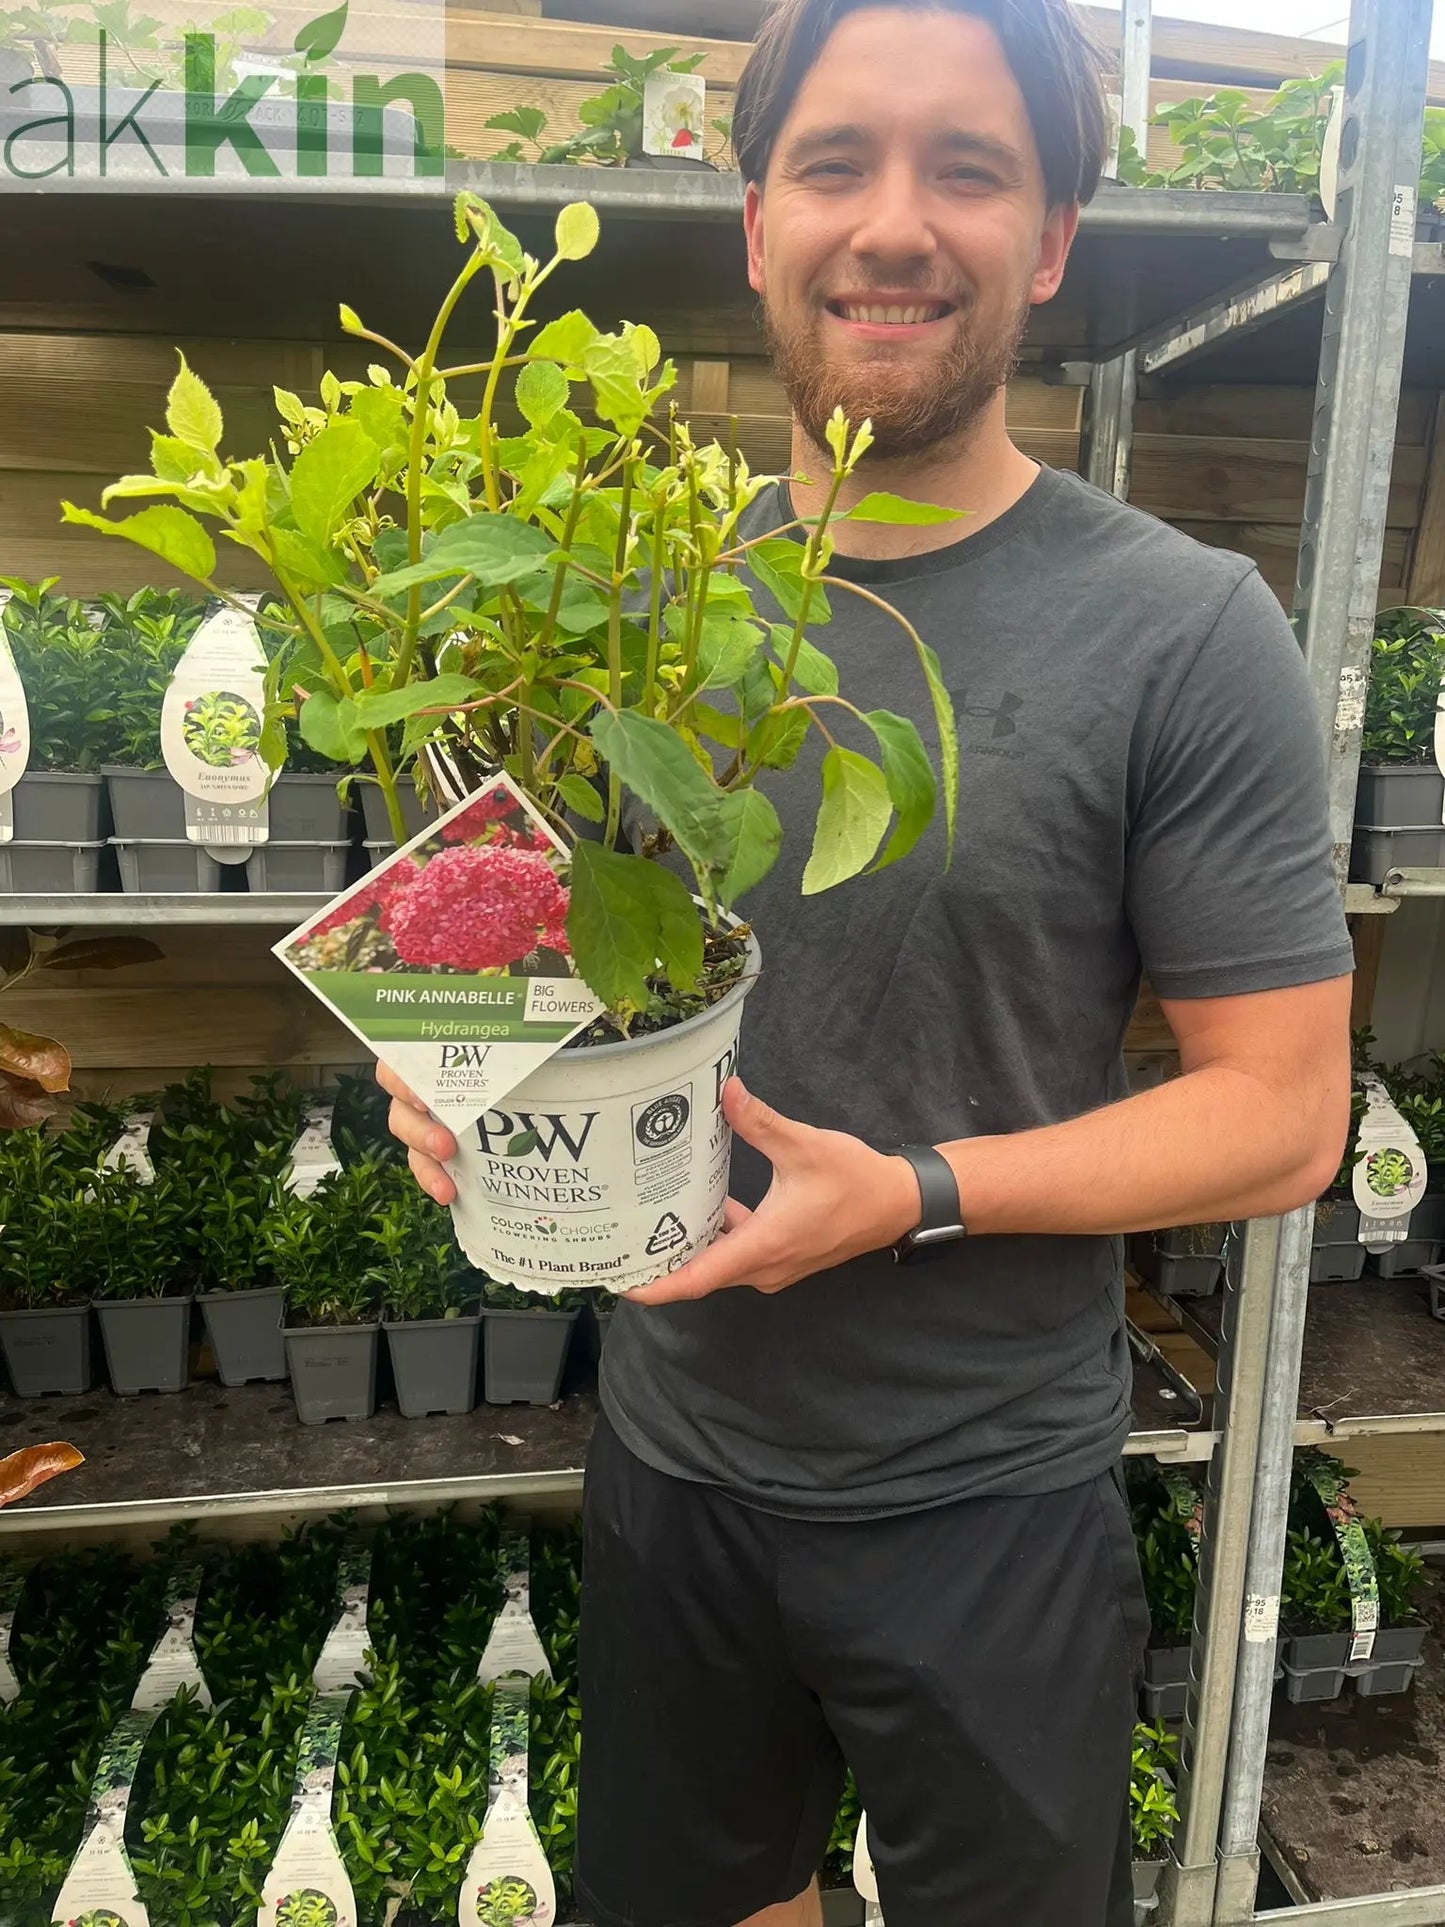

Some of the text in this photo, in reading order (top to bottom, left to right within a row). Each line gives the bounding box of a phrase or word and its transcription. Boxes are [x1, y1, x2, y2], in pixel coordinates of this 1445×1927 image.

[376, 989, 515, 1005] PINK ANNABELLE
[533, 985, 554, 997] BIG
[531, 1001, 595, 1013] FLOWERS
[420, 1021, 510, 1038] Hydrangea
[439, 1044, 492, 1068] PW
[441, 1070, 483, 1079] PROVEN
[476, 1108, 601, 1163] PW
[486, 1159, 590, 1184] PROVEN
[490, 1215, 533, 1232] COLOR
[492, 1226, 611, 1243] FLOWERING SHRUBS
[491, 1247, 515, 1265] The
[519, 1257, 534, 1270] #1
[539, 1260, 576, 1273] Plant
